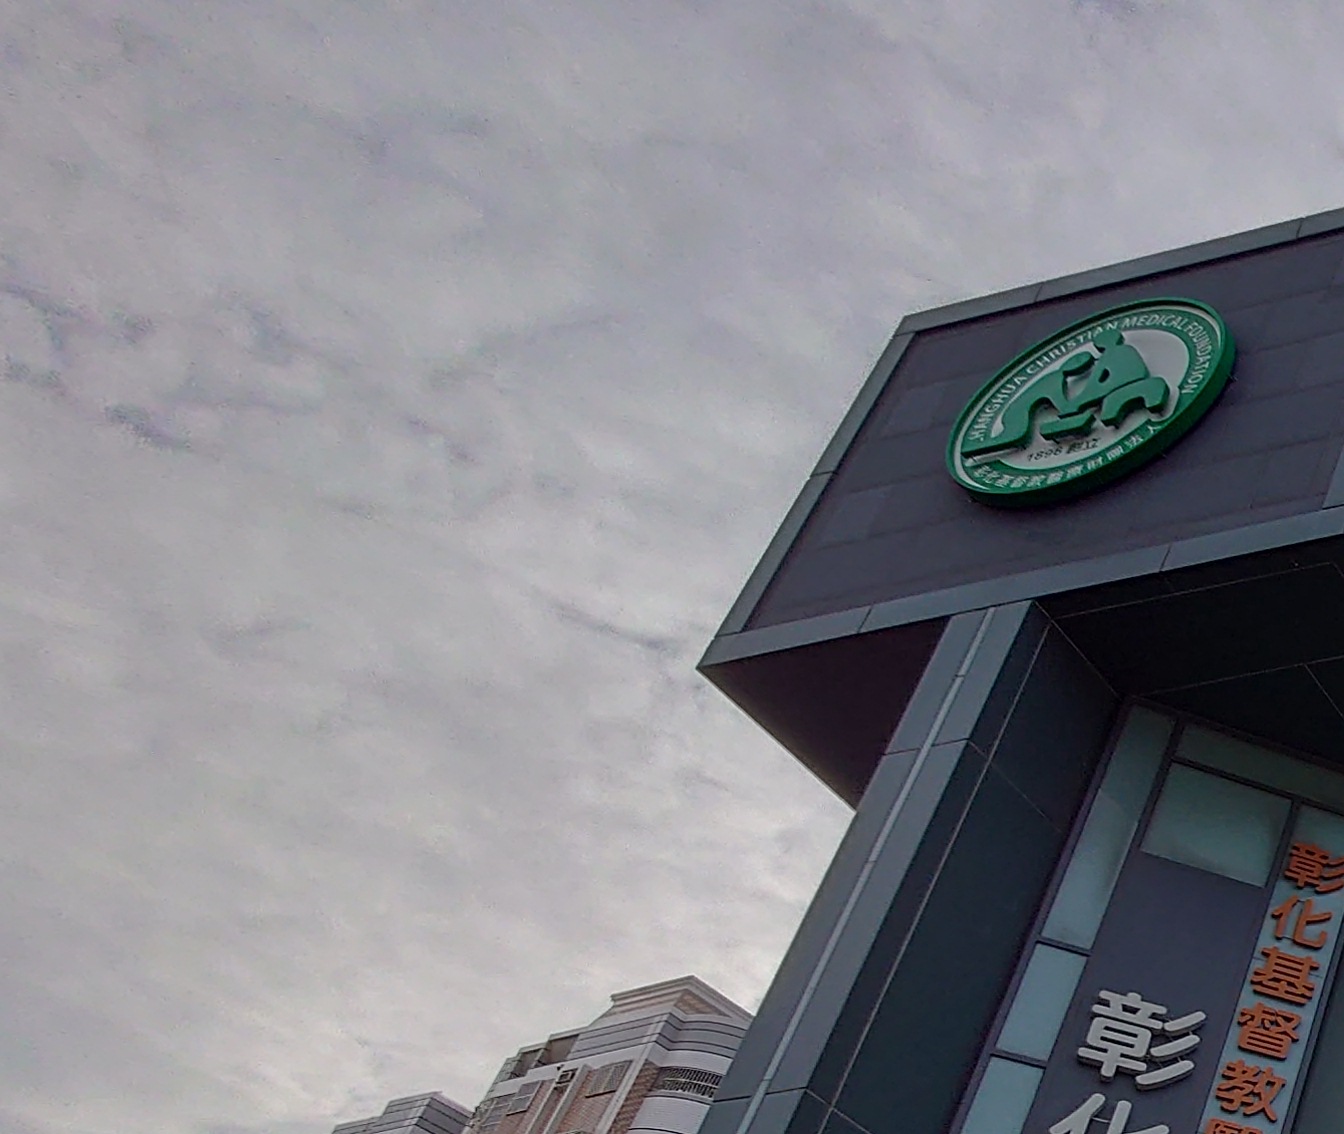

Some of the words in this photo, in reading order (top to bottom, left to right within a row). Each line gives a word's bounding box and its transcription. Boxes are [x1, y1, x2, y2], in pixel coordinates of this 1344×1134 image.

[967, 375, 1028, 441] HANGHUA
[1026, 321, 1120, 374] CHRISTIAN
[1120, 313, 1185, 331] MEDICAL
[1182, 319, 1213, 395] FOUNDATION
